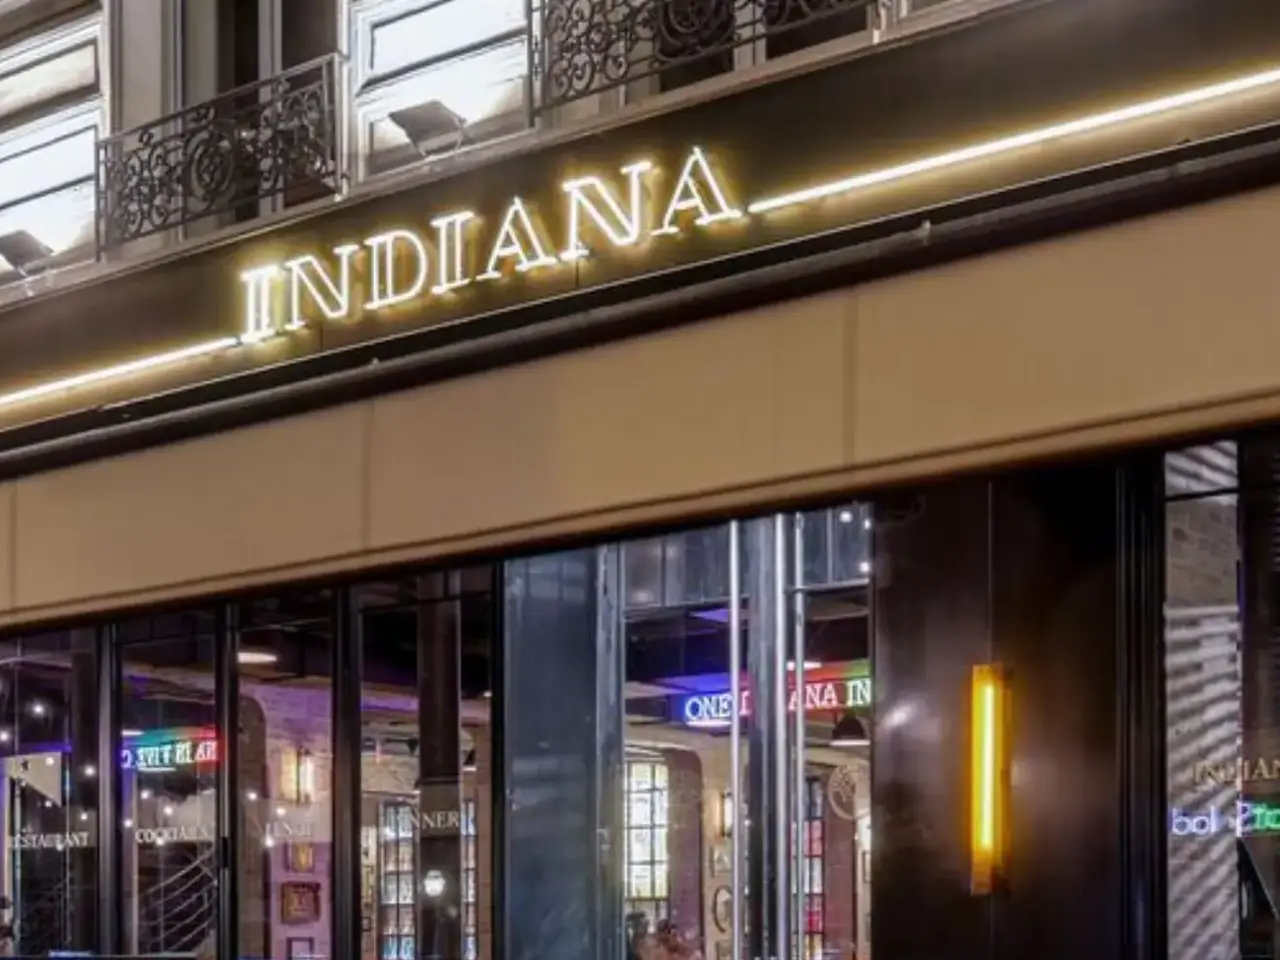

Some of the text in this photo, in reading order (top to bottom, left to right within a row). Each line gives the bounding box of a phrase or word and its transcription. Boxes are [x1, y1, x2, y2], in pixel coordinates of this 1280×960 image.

[239, 145, 743, 343] INDIANA
[685, 693, 733, 720] ONE
[739, 682, 839, 717] IANA
